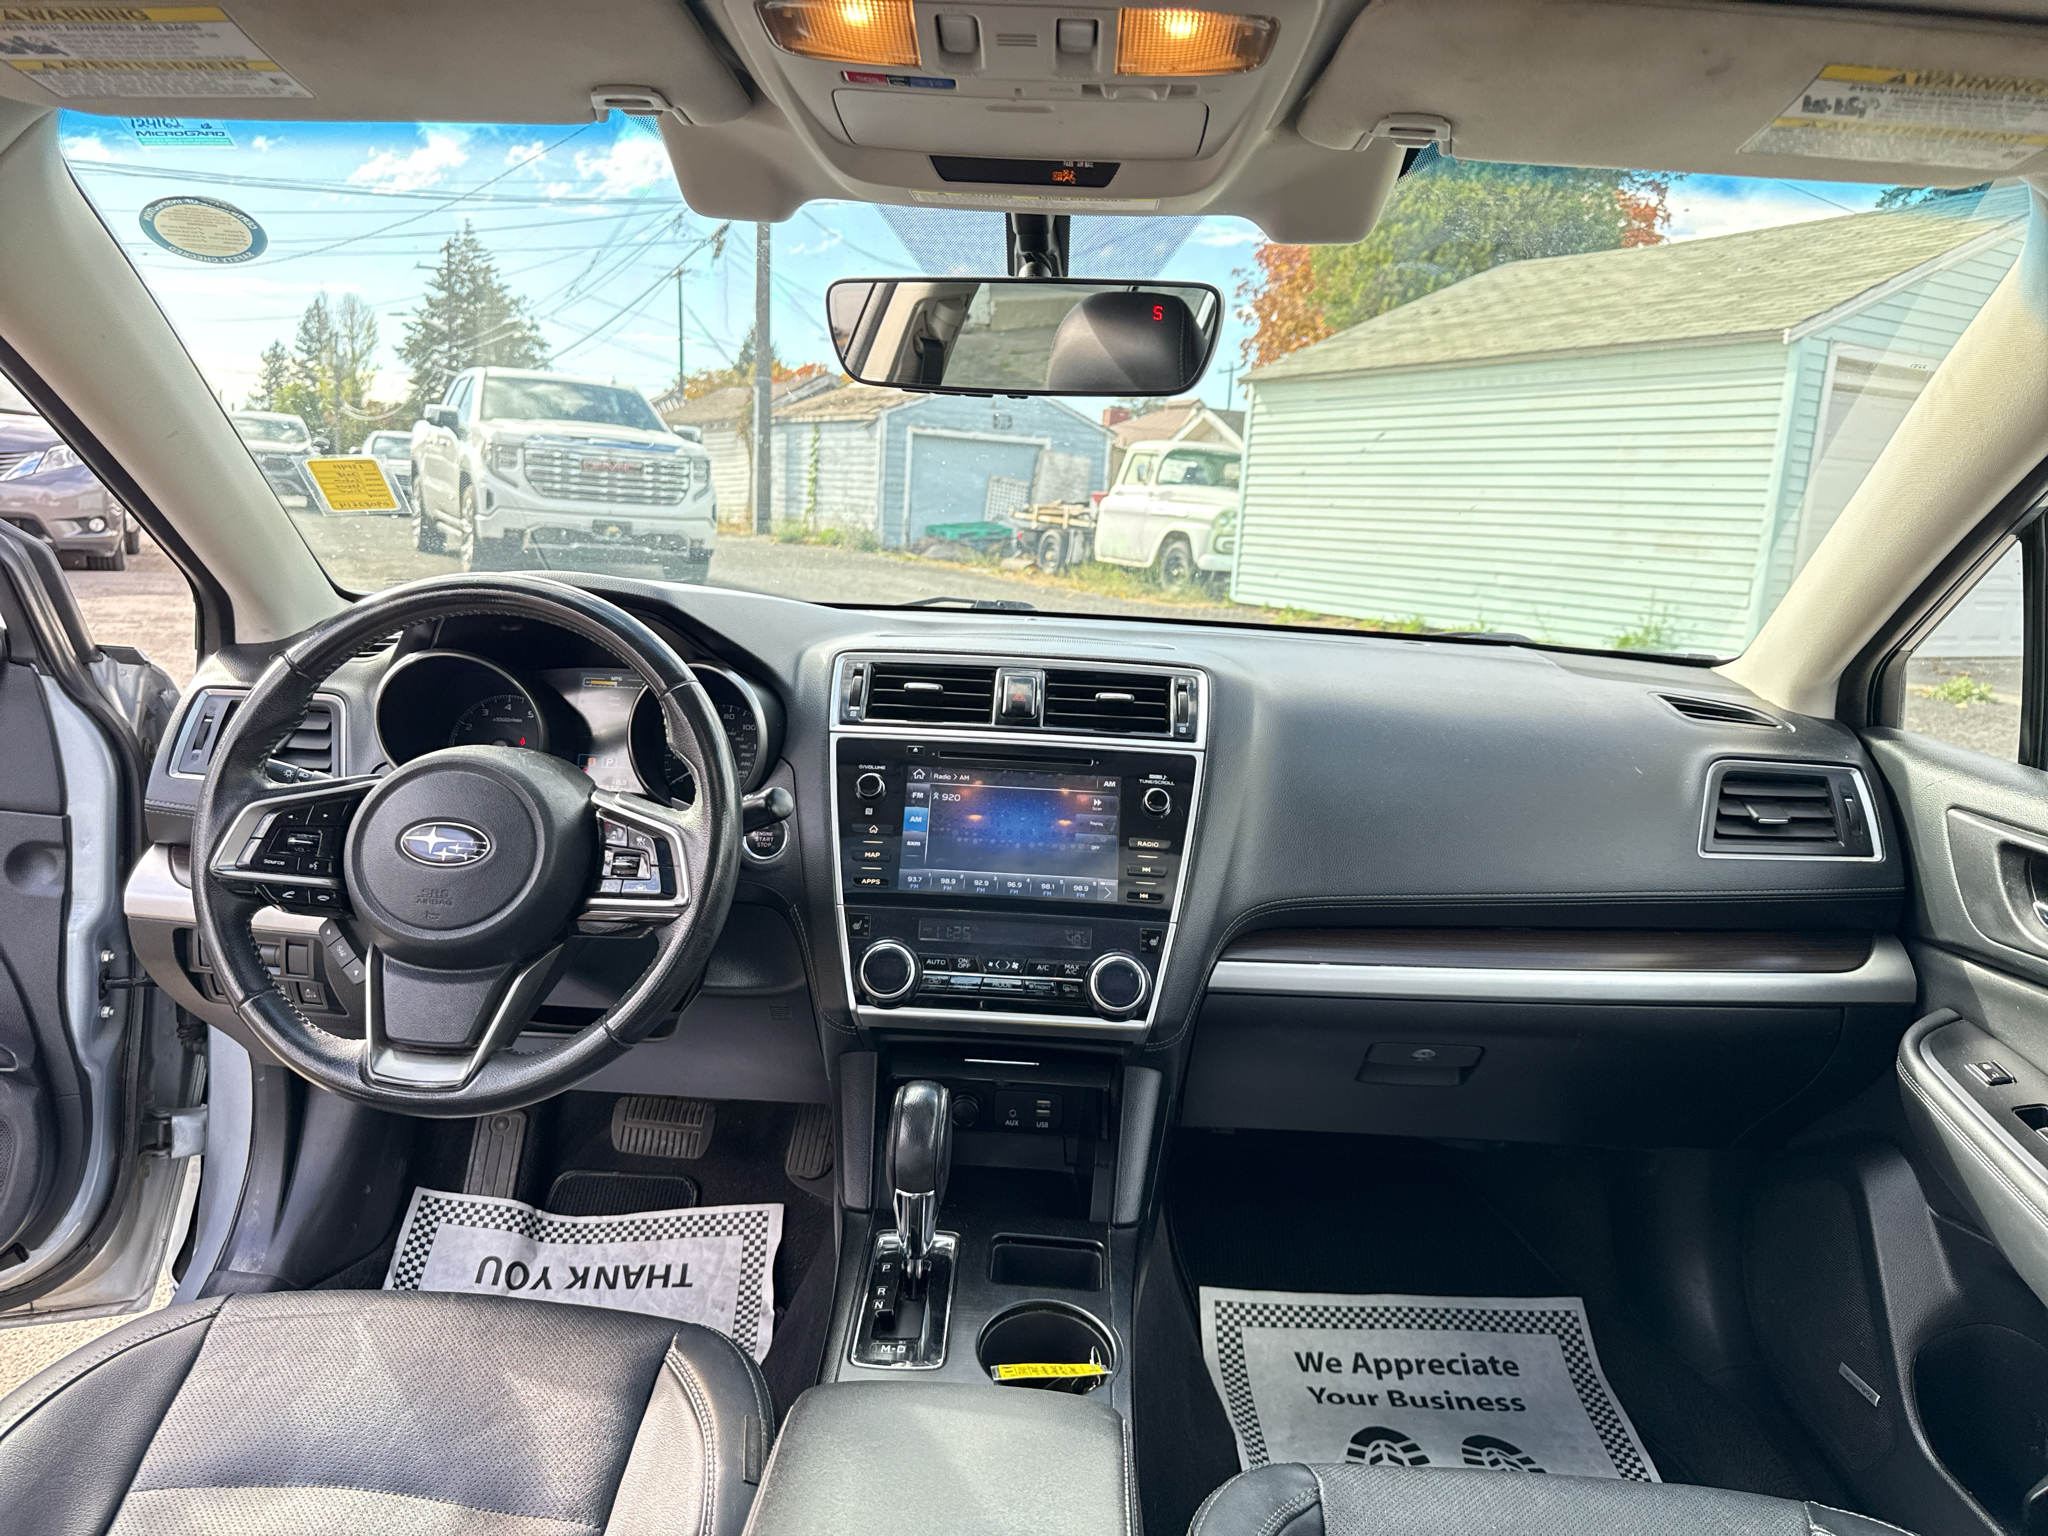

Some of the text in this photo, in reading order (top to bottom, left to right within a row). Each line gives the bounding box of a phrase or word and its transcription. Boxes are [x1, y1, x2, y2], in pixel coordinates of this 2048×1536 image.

[18, 8, 151, 20] WARNING
[583, 459, 643, 473] GMC
[505, 703, 512, 711] 4
[941, 793, 961, 802] 920
[263, 858, 285, 866] Source
[926, 958, 947, 966] AUTO
[1005, 1119, 1019, 1127] AUX
[474, 1255, 694, 1290] THANK YOU
[881, 1264, 891, 1273] P
[877, 1287, 886, 1296] R
[873, 1301, 884, 1309] N
[1294, 1350, 1521, 1381] We Appreciate
[1307, 1385, 1527, 1413] Your Business
